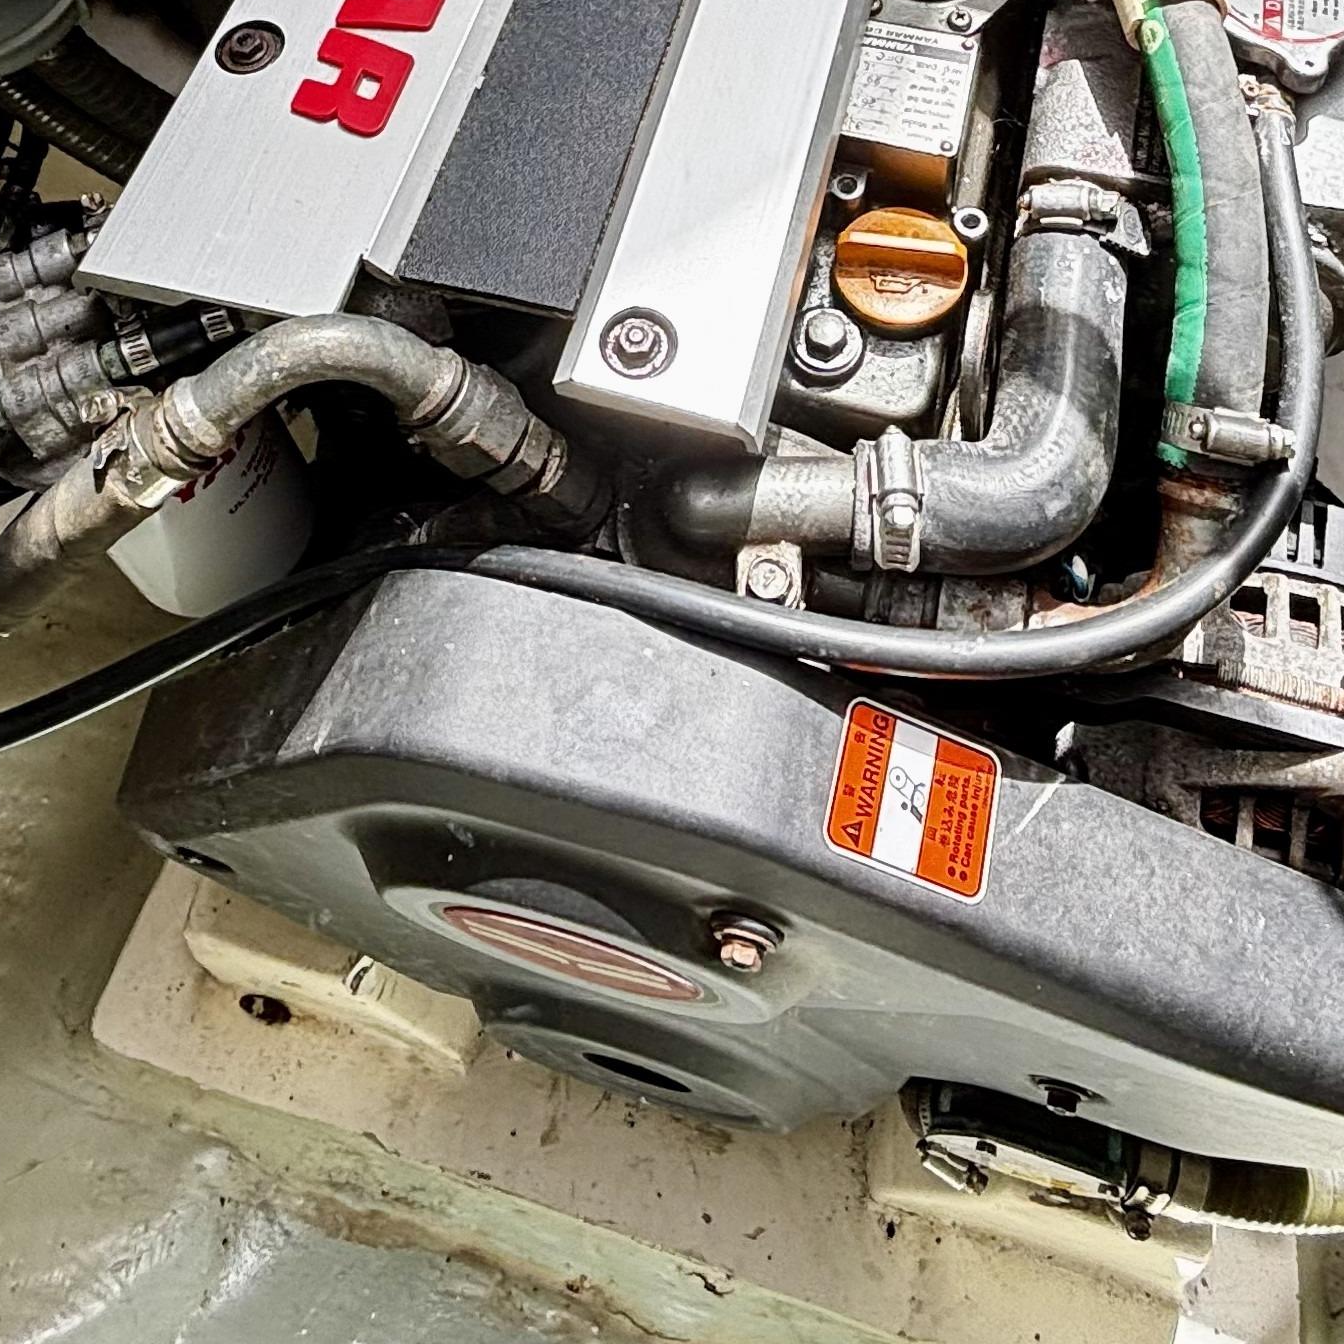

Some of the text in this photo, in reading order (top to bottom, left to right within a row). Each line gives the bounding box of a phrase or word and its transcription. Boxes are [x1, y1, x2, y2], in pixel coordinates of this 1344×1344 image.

[862, 35, 915, 53] YANMA
[855, 714, 890, 817] WARNING
[949, 777, 970, 864] Rotating parts.
[966, 803, 978, 840] cause
[961, 843, 972, 867] Can
